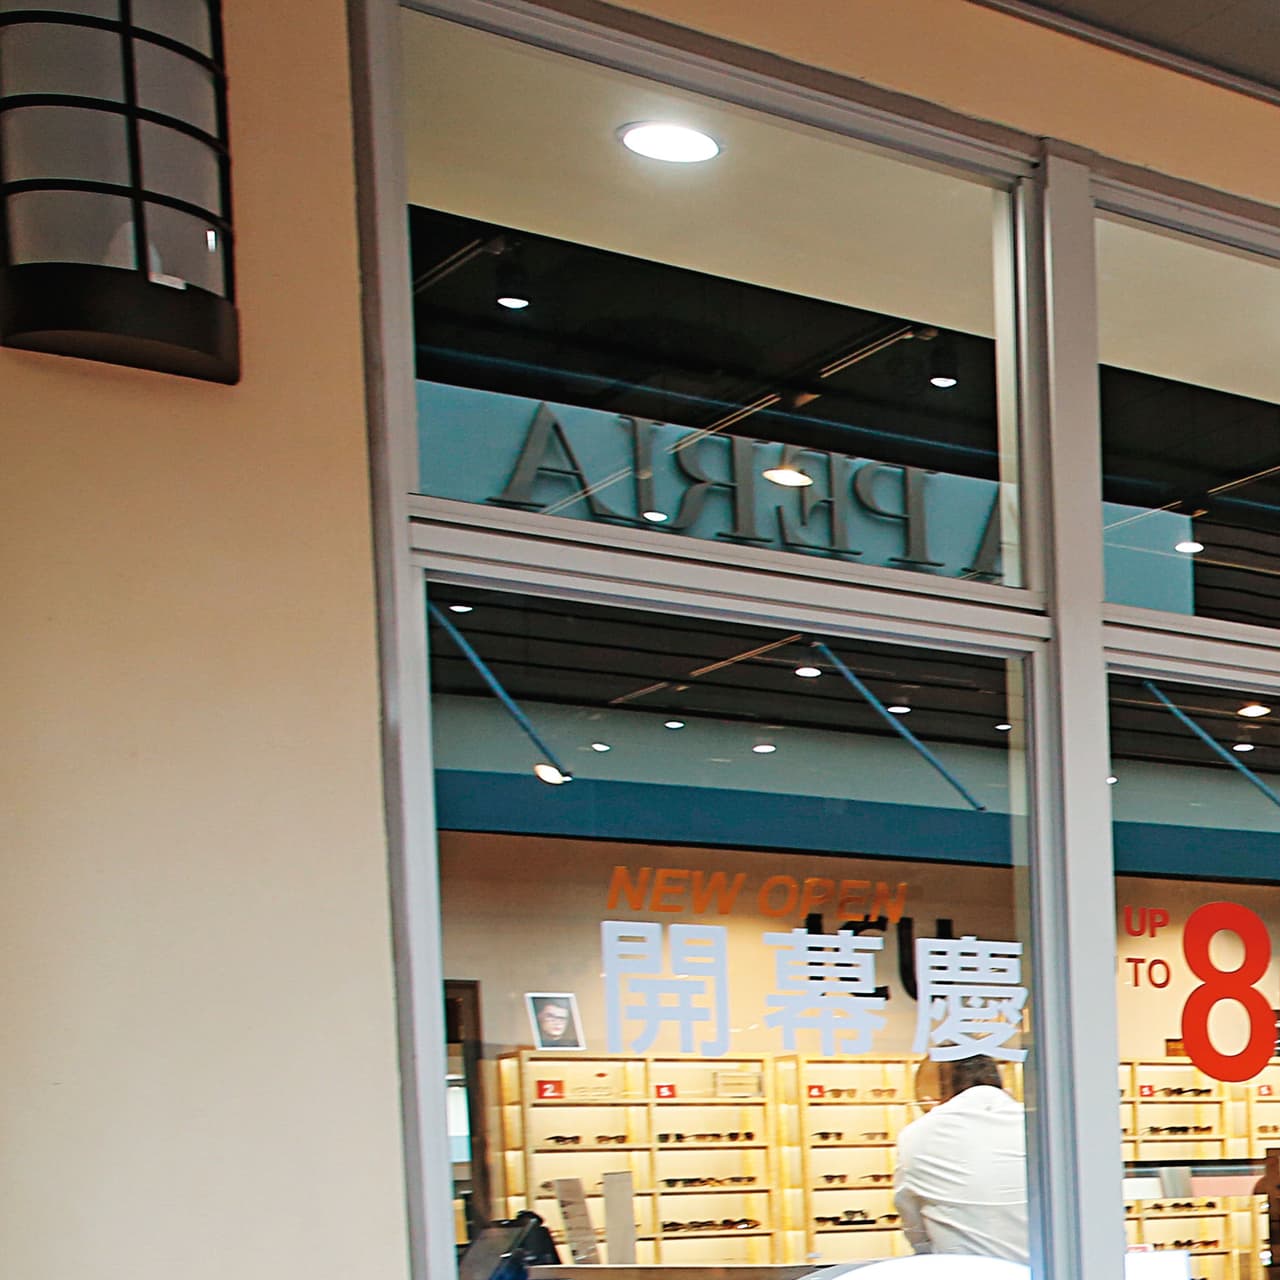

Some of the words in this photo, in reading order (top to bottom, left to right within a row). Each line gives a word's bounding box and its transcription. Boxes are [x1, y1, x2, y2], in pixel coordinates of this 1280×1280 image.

[606, 865, 746, 915] NEW
[757, 874, 908, 923] OPEN
[1124, 905, 1170, 938] UP
[600, 919, 1028, 1063] 開幕慶
[1125, 957, 1171, 989] TO
